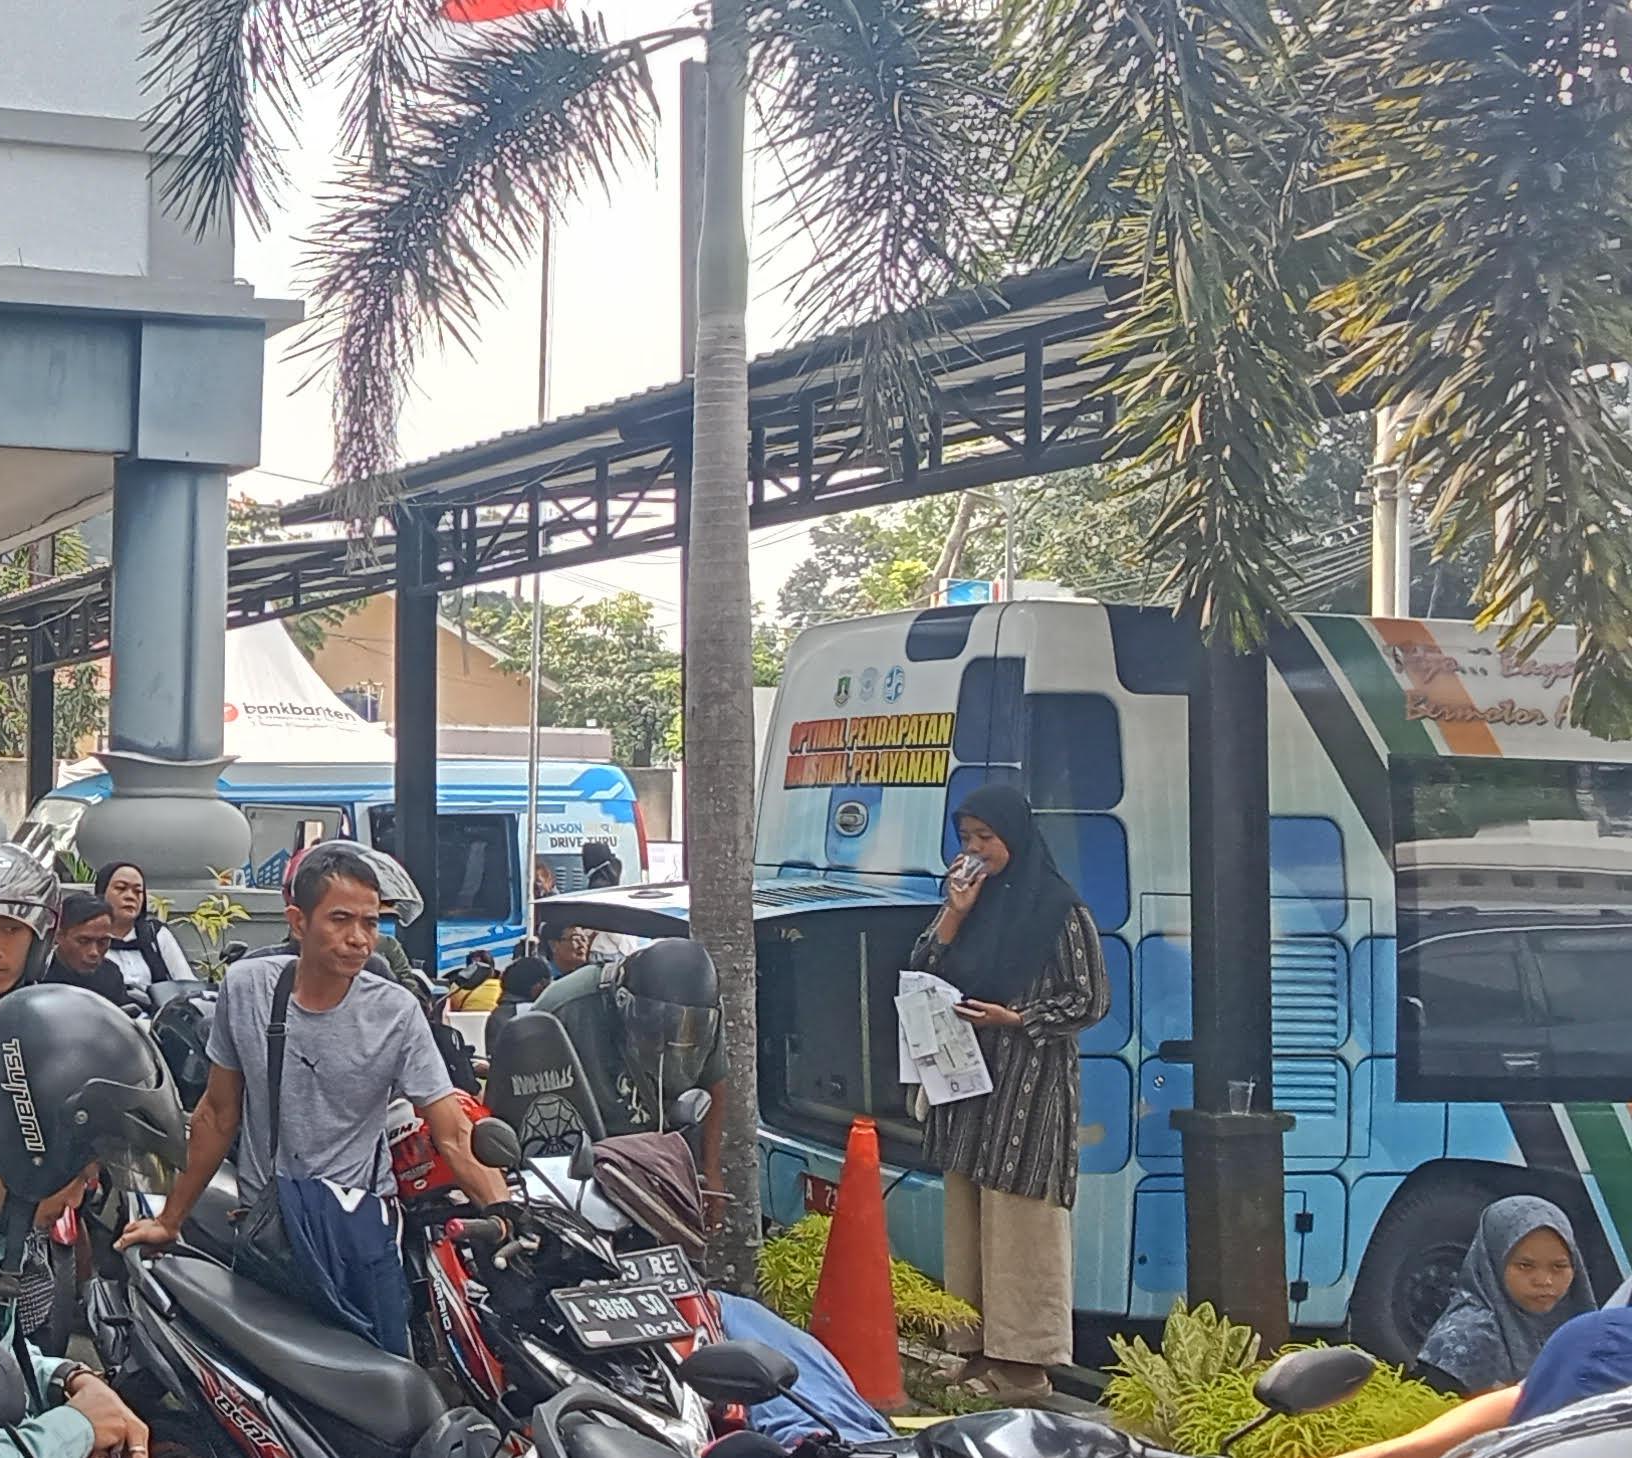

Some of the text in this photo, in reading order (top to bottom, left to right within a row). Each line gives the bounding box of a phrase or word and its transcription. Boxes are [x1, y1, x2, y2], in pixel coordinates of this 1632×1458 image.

[242, 702, 357, 722] bankbanten
[790, 712, 955, 754] OPTIMAL PENDAPATAN
[784, 750, 950, 790] MAKSIMAL PELAYANAN
[536, 823, 583, 834] SAMSON
[549, 837, 584, 848] DRIVE
[805, 1178, 814, 1201] A
[647, 1252, 679, 1277] RE
[567, 1300, 590, 1324] A
[587, 1296, 639, 1321] 3860
